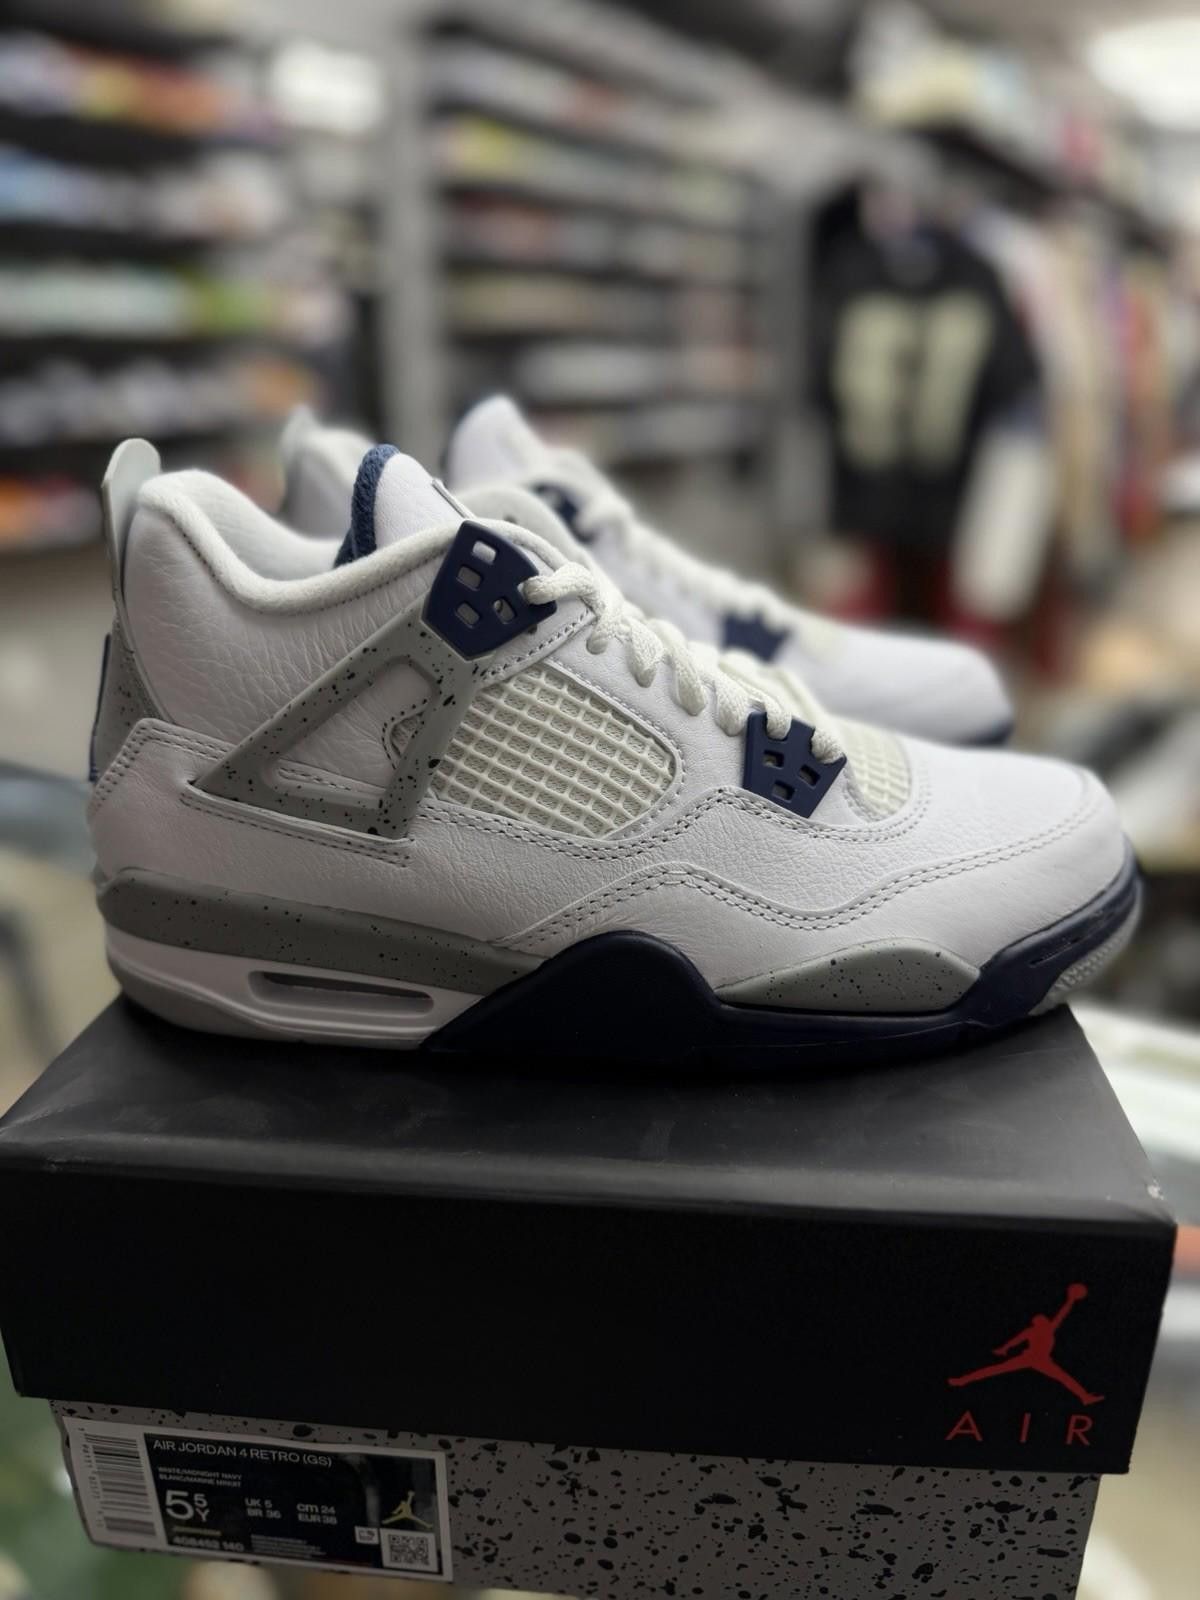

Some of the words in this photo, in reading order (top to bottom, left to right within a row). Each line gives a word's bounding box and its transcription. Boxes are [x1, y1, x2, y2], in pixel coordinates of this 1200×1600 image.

[944, 1410, 1093, 1446] AIR
[153, 1440, 175, 1451] AIR
[178, 1442, 236, 1457] JORDAN
[239, 1448, 247, 1459] 4
[250, 1448, 299, 1463] RETRO
[302, 1454, 332, 1468] (GS)
[244, 1498, 262, 1508] UK
[246, 1508, 263, 1518] BR
[296, 1503, 319, 1513] cm
[320, 1505, 336, 1515] 24
[297, 1513, 321, 1524] EUR
